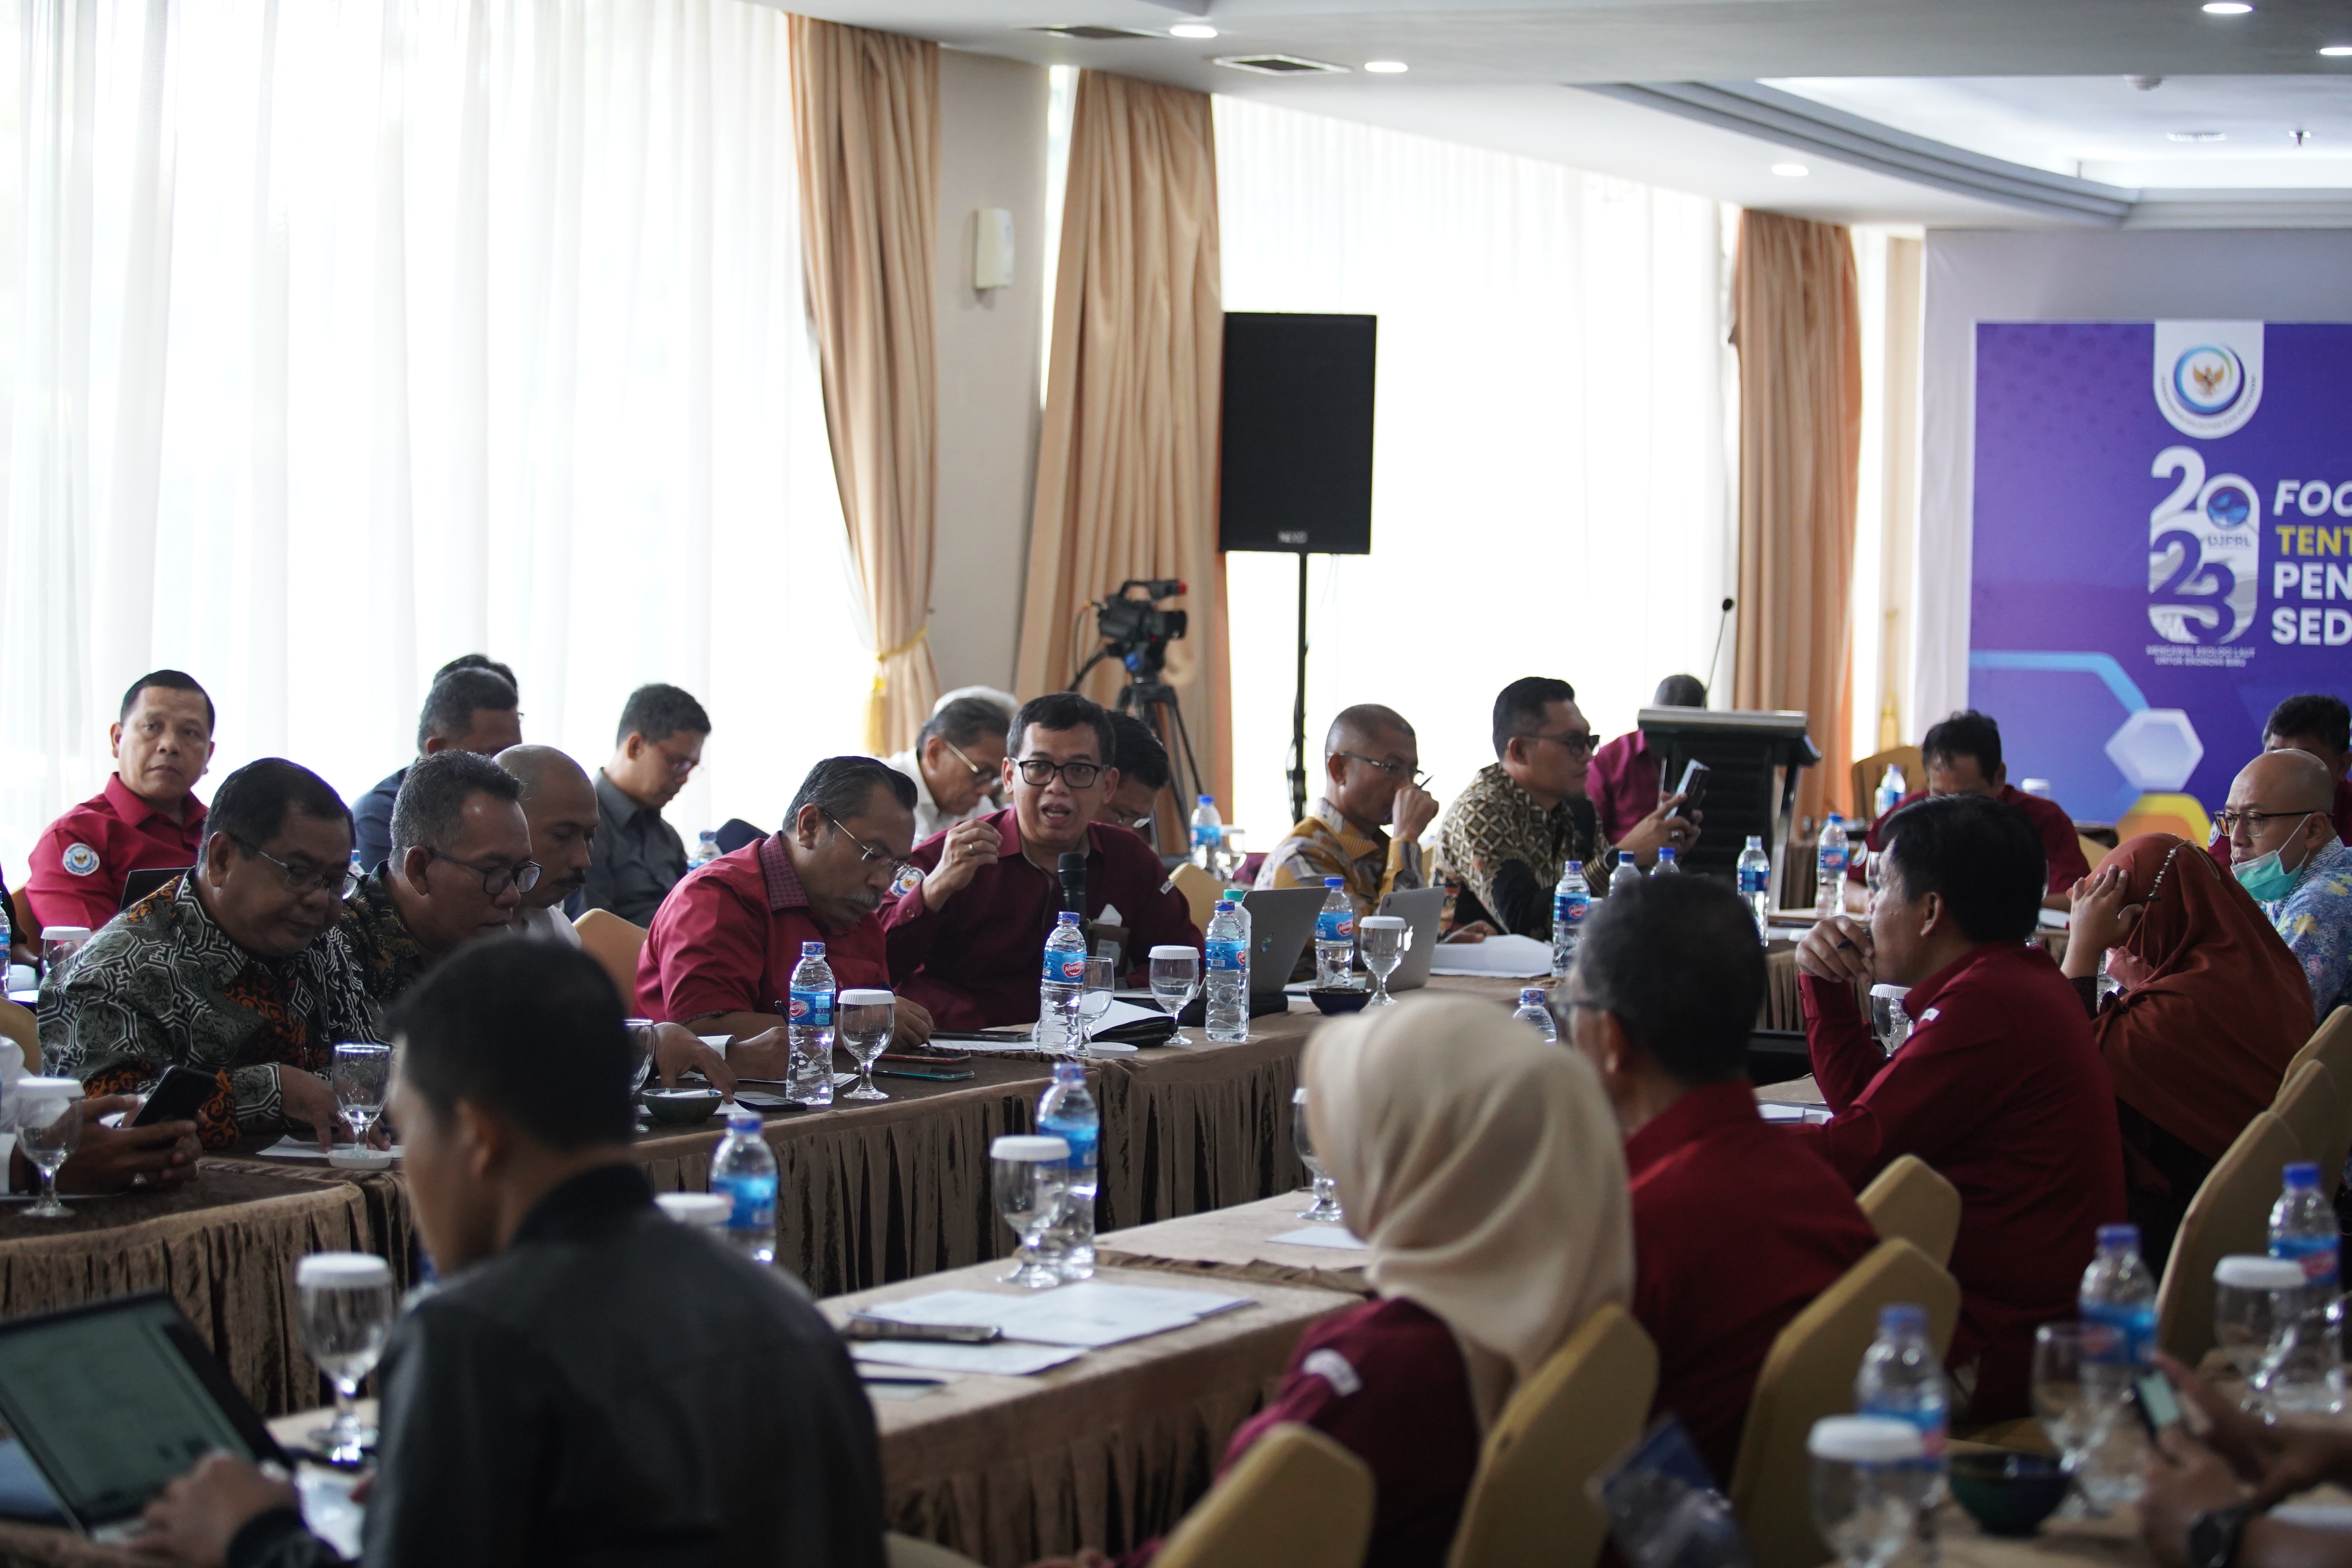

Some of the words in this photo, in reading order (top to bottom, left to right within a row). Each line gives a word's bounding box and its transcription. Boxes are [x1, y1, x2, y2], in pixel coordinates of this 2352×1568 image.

[2273, 479, 2352, 517] FOC
[2273, 561, 2352, 600] PEN
[2271, 606, 2352, 646] SED
